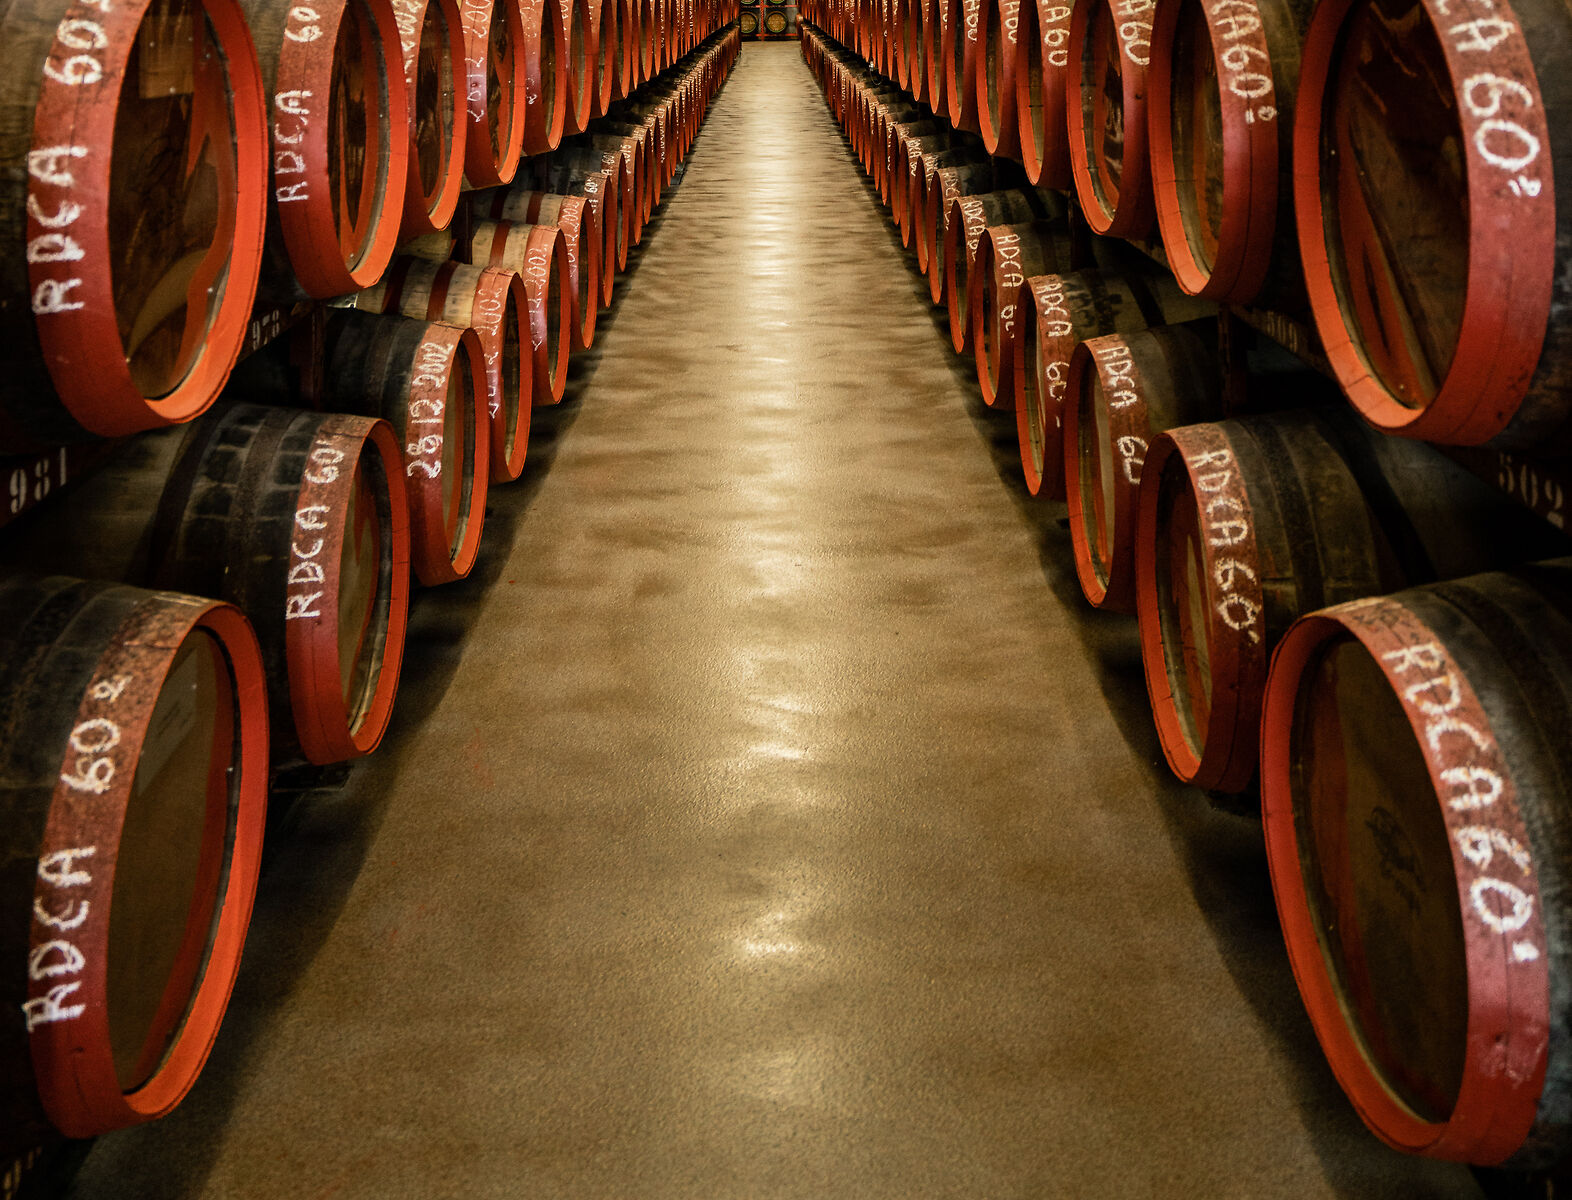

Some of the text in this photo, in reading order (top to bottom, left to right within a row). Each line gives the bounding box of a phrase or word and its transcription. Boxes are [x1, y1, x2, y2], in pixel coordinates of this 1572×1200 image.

[275, 89, 314, 203] RDCA
[27, 144, 89, 315] RDCA
[995, 232, 1025, 288] RDCA
[1035, 282, 1073, 338] RDCA
[1096, 346, 1138, 409] RDCA
[9, 448, 67, 514] 981
[1186, 449, 1249, 546] RDCA
[285, 504, 331, 621] RDCA
[1381, 641, 1504, 811] RDCA
[21, 845, 98, 1034] RDCA
